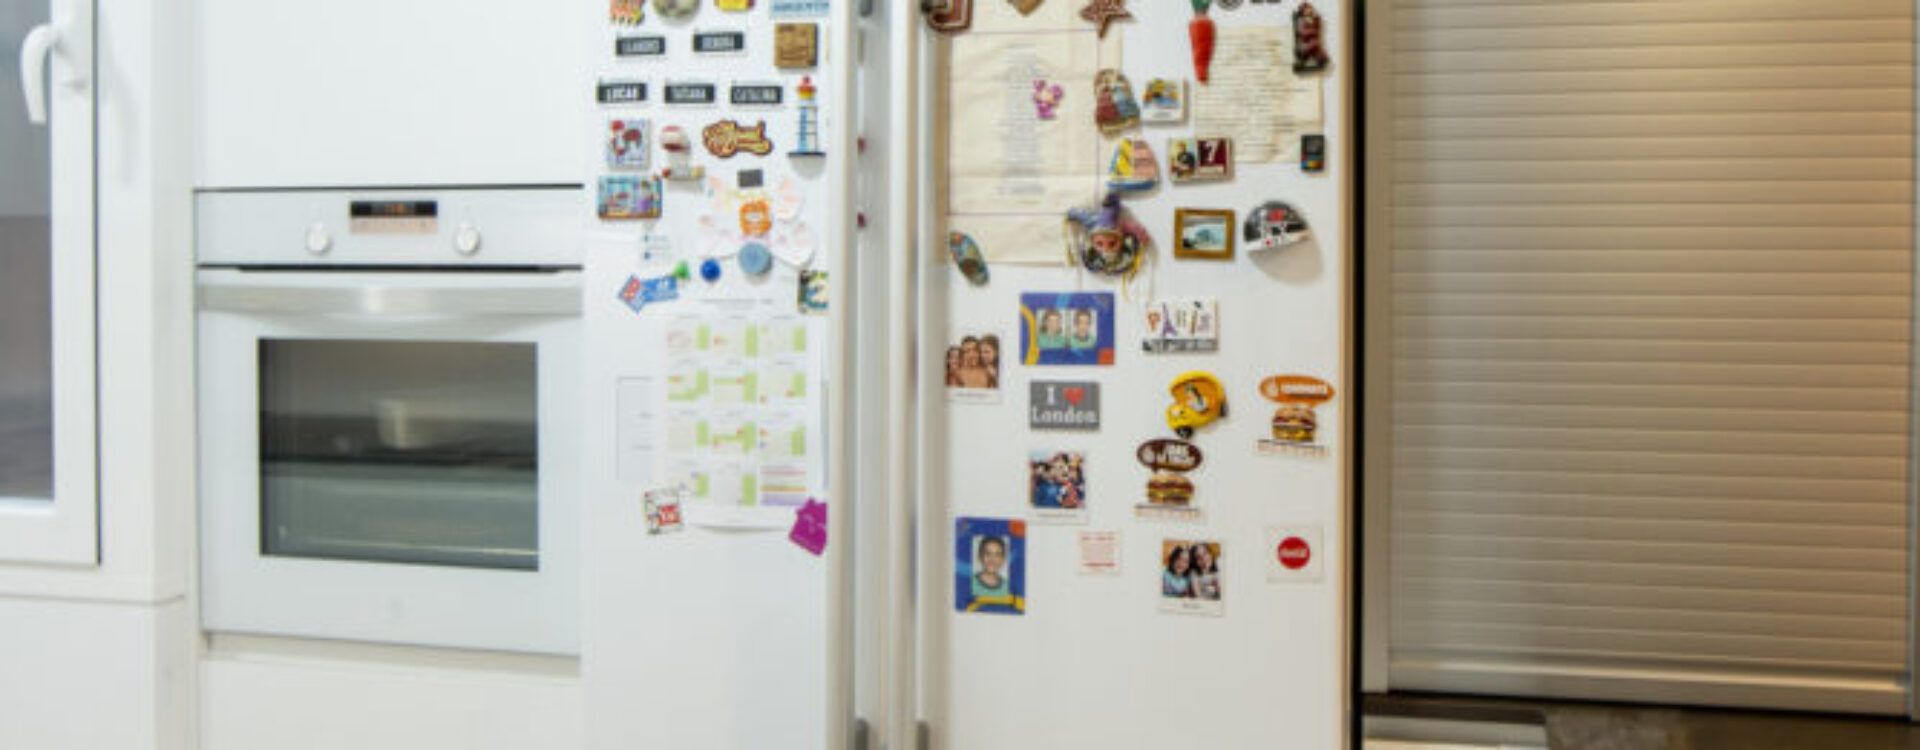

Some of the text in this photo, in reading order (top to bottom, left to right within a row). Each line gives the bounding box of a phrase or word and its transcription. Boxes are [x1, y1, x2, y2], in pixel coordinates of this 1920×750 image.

[607, 84, 639, 101] LUCAS
[734, 87, 778, 101] CATALINA
[1047, 386, 1056, 405] I
[1032, 405, 1097, 424] London
